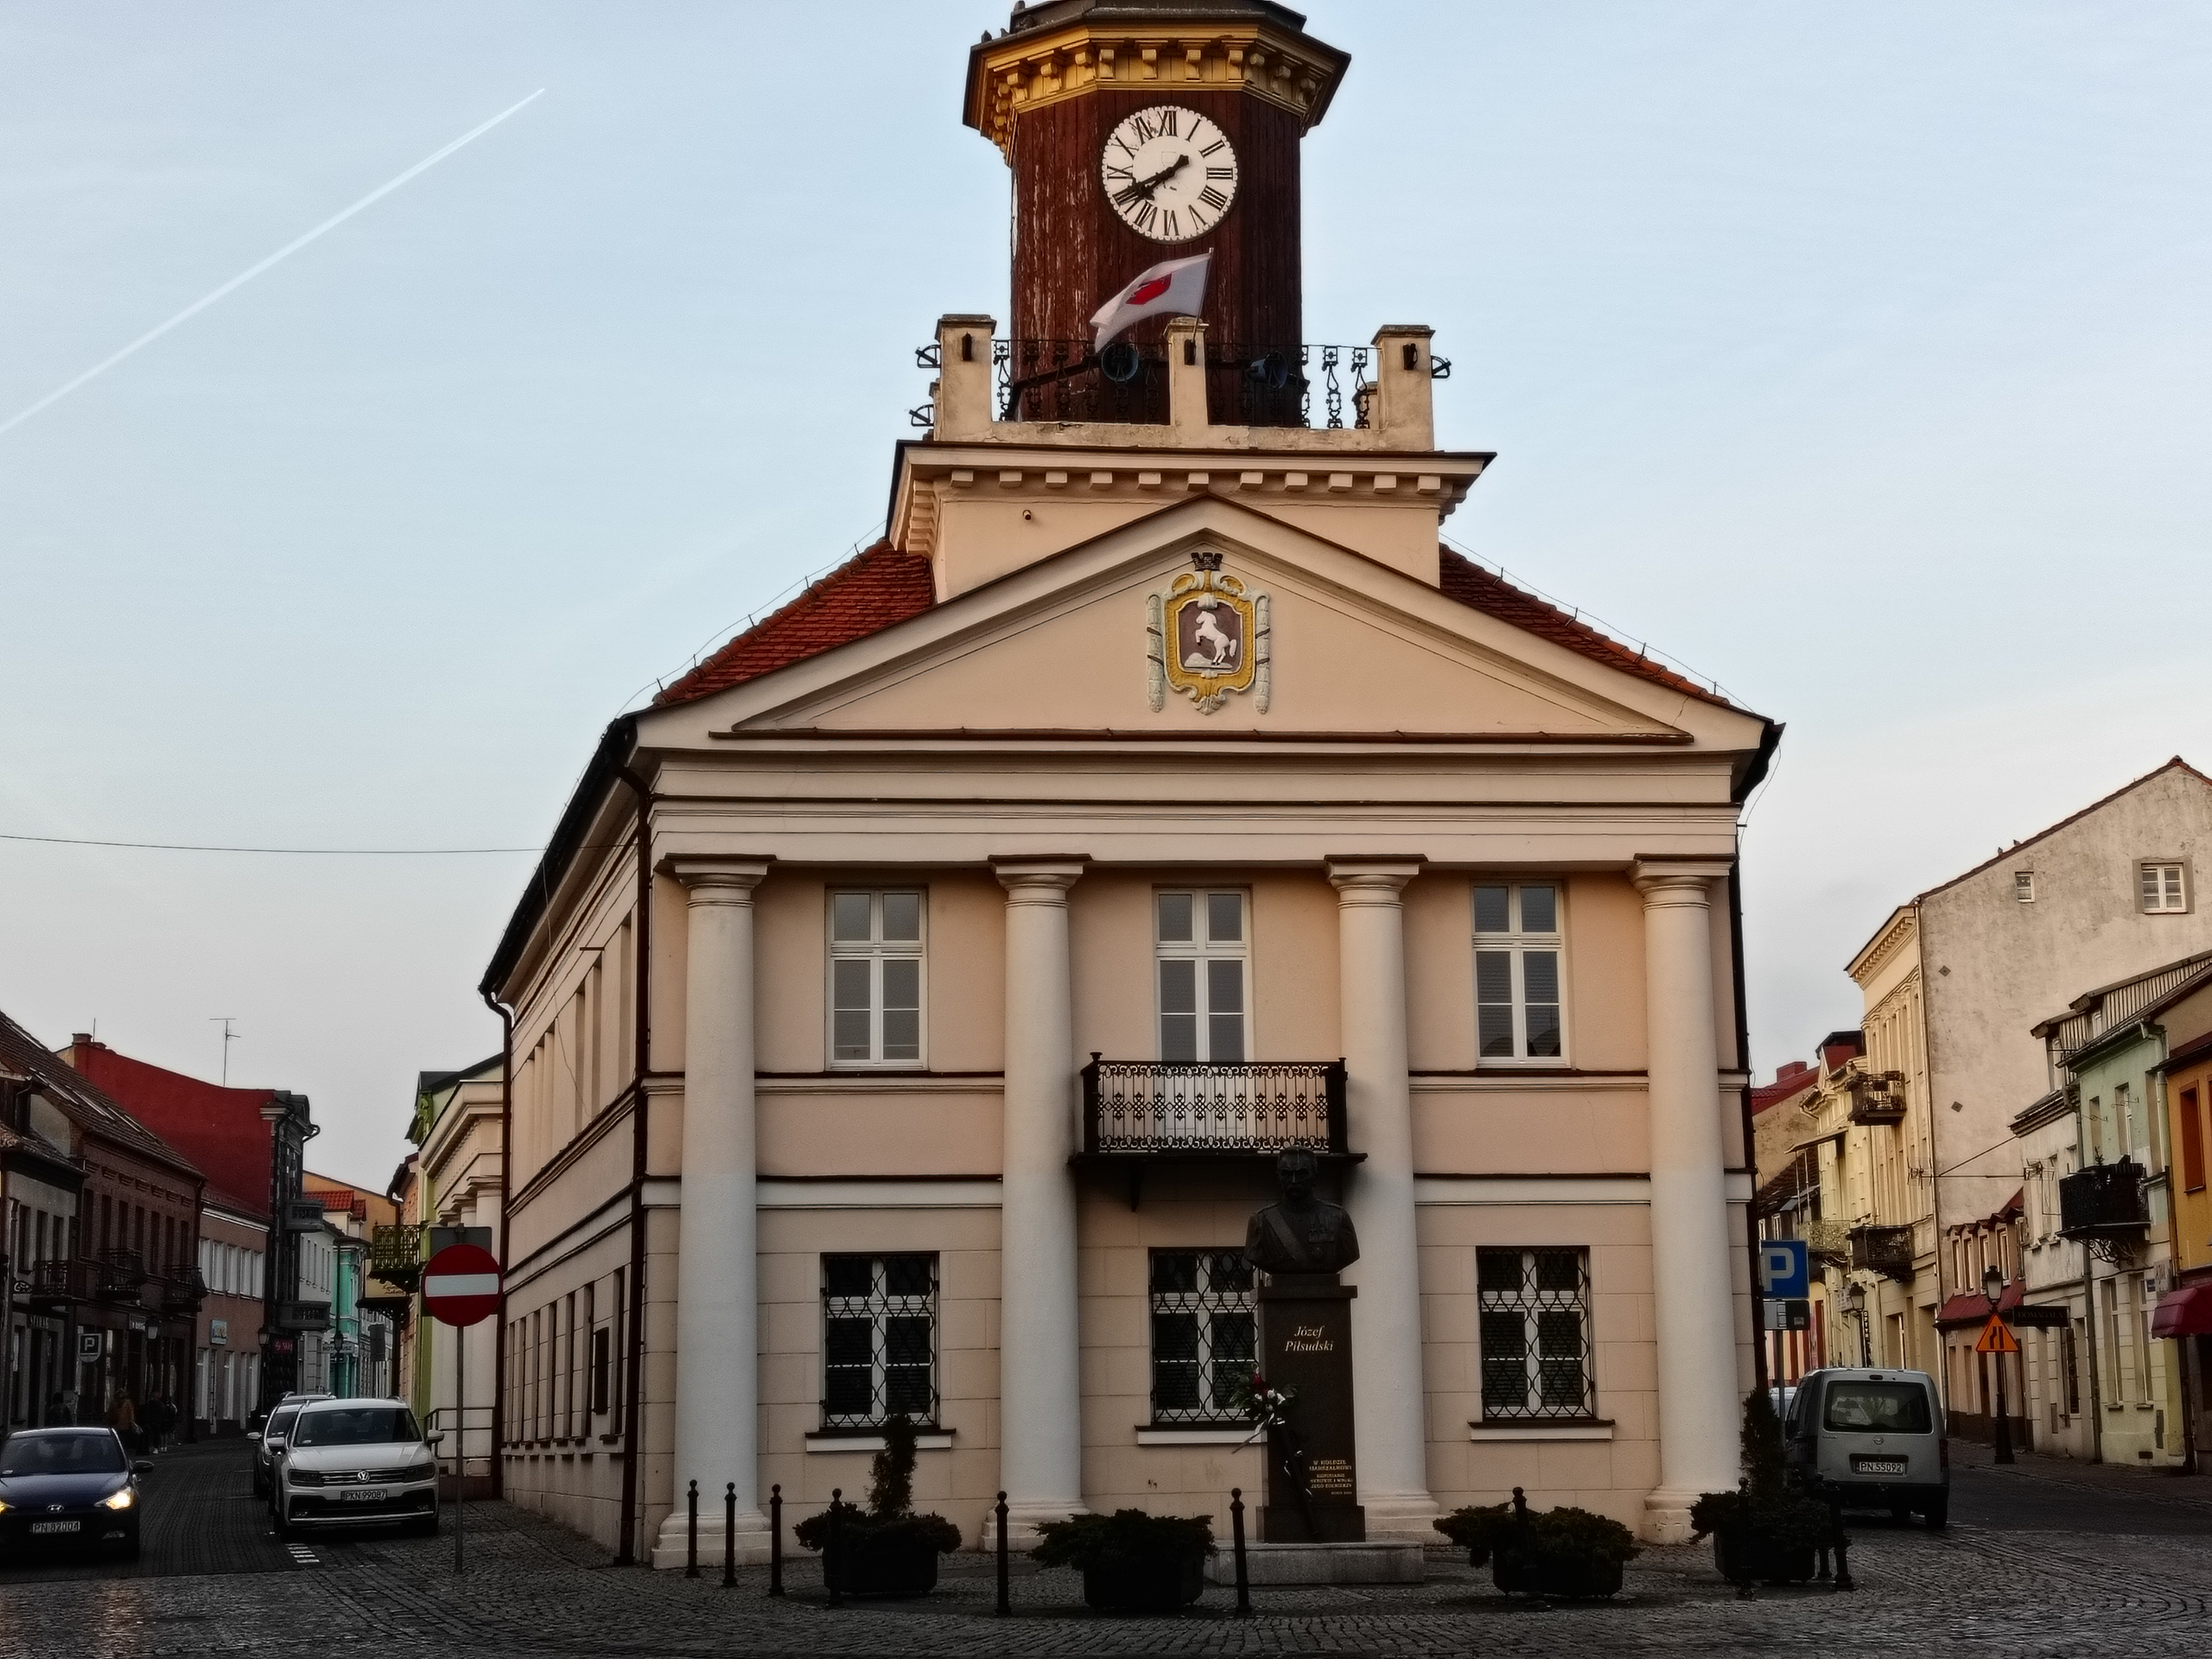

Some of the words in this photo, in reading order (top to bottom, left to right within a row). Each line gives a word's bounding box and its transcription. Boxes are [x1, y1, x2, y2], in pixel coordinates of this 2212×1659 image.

[1158, 111, 1178, 137] XII
[1762, 1248, 1795, 1292] P
[1294, 1325, 1325, 1338] Józef
[84, 1337, 95, 1351] P
[1860, 1462, 1873, 1471] PN
[1876, 1463, 1902, 1472] 55092
[363, 1491, 386, 1499] 99087
